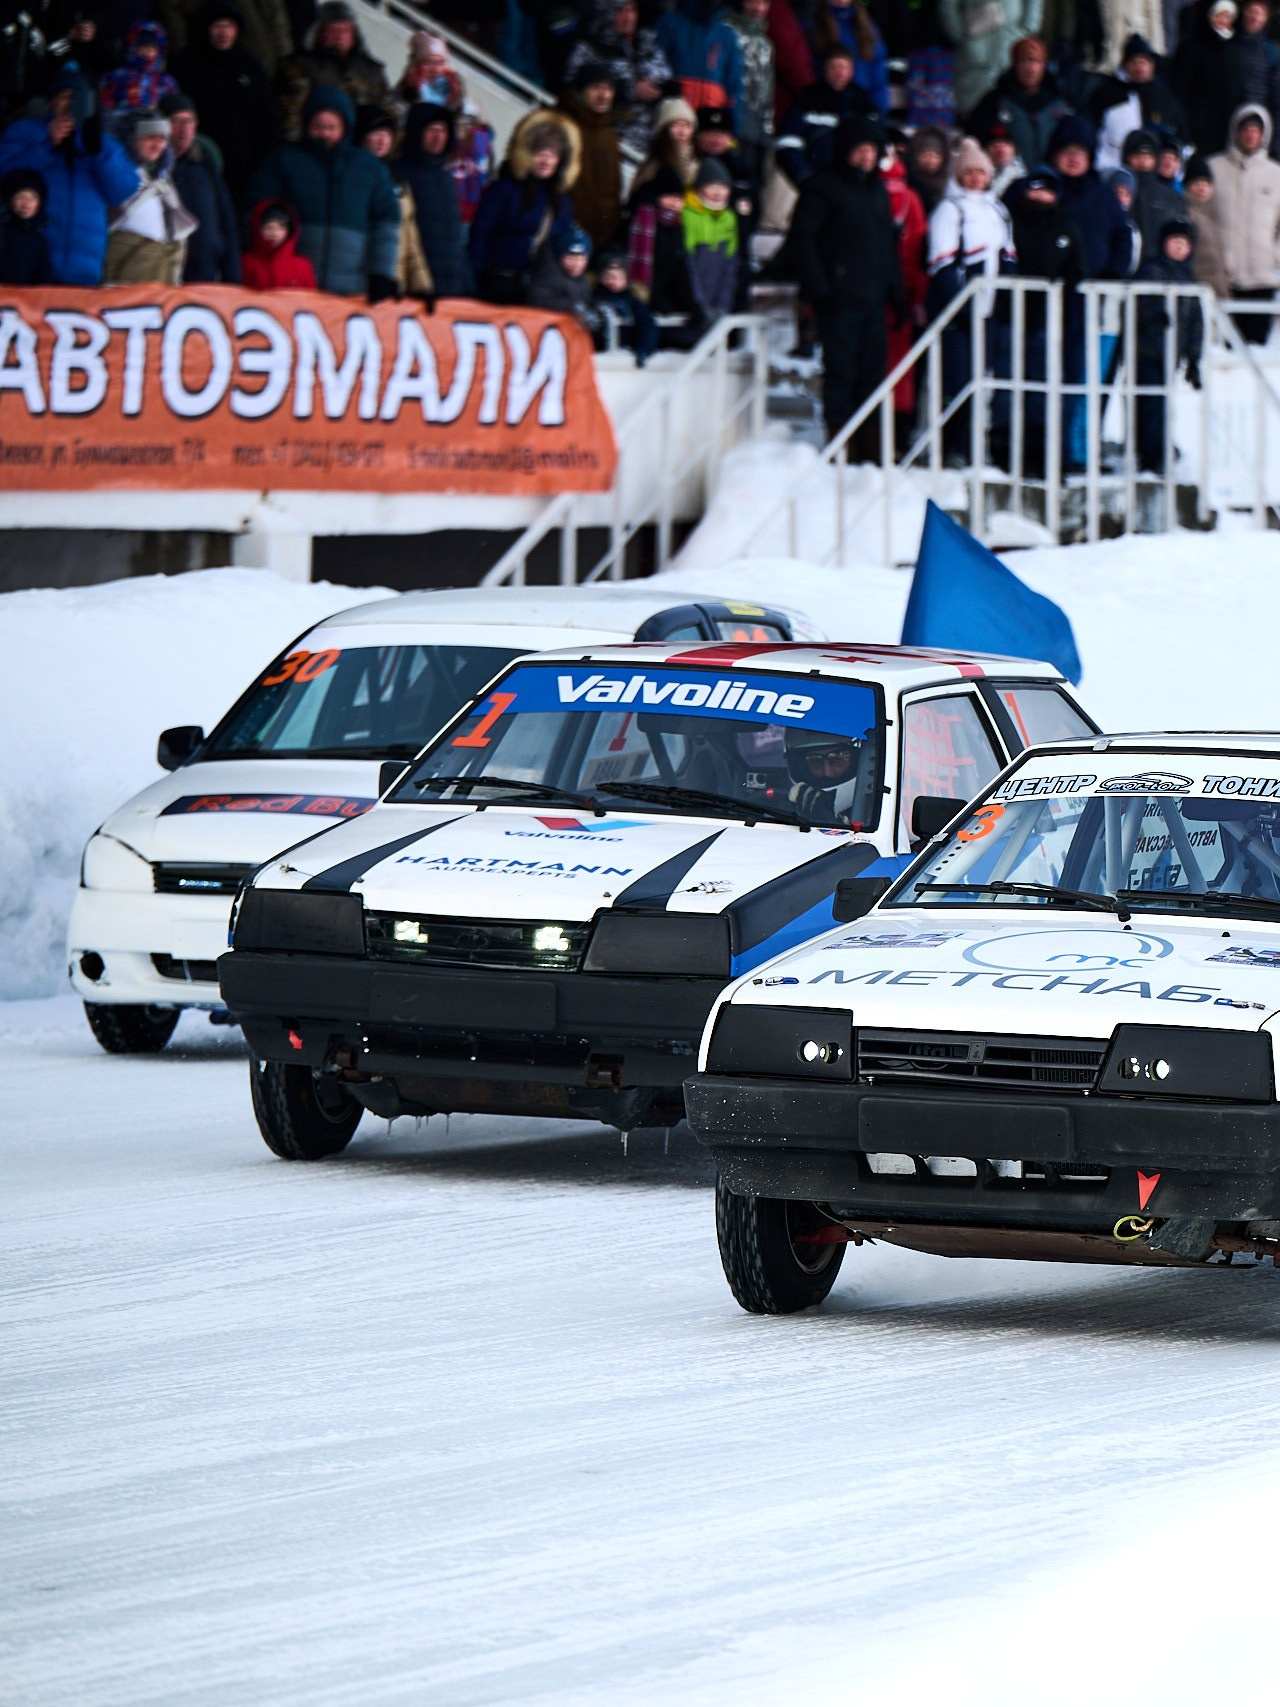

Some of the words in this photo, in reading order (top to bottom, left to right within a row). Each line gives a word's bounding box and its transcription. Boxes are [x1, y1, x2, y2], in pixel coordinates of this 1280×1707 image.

[0, 303, 567, 426] АВТОЭМАЛИ
[261, 648, 341, 686] 30
[557, 673, 815, 719] Valvoline
[451, 692, 517, 748] 1
[187, 795, 304, 812] Red
[994, 774, 1097, 800] ЦЕНТР
[504, 830, 624, 843] Valvoline
[957, 804, 1004, 841] 3
[396, 856, 634, 877] HARTMANN
[806, 969, 1221, 1003] МЕТСНАБ
